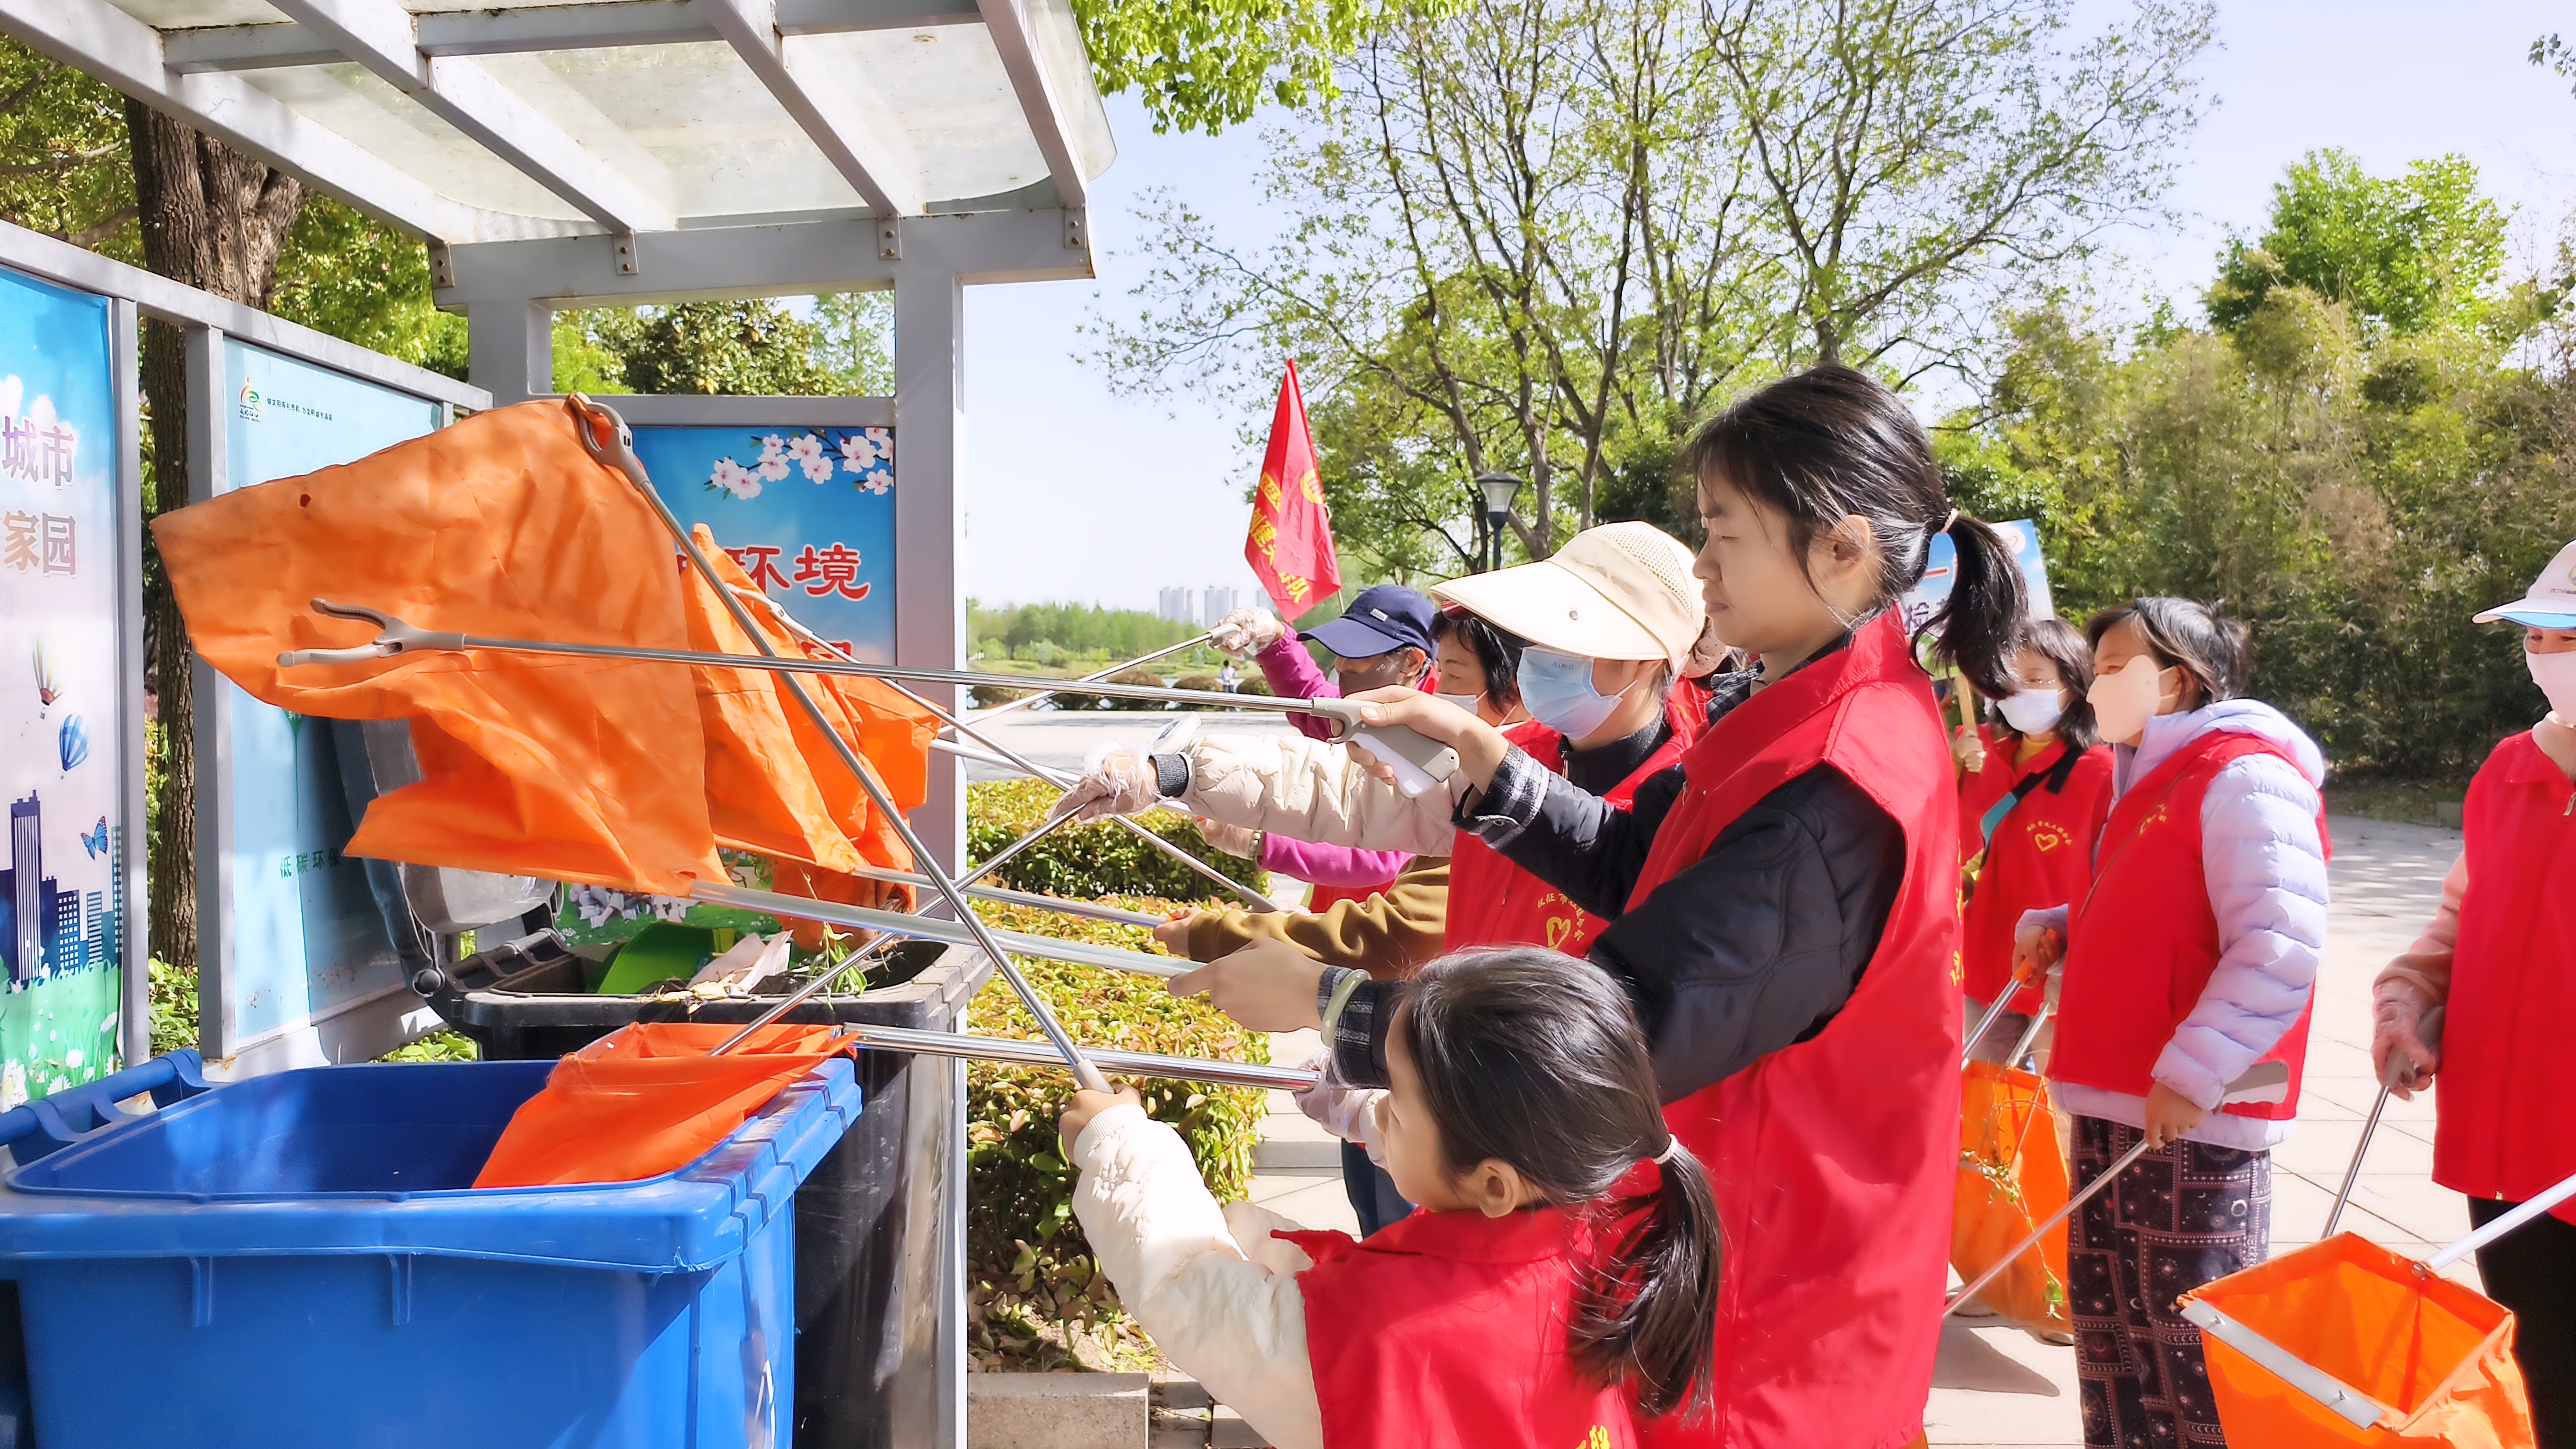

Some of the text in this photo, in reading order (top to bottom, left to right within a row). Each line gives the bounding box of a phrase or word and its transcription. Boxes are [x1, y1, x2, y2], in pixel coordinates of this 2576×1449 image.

[3, 416, 74, 486] 城市
[3, 510, 76, 575] 家园
[677, 543, 870, 601] 环境
[1552, 662, 1574, 670] ALLMD
[280, 847, 340, 878] 低碳环保
